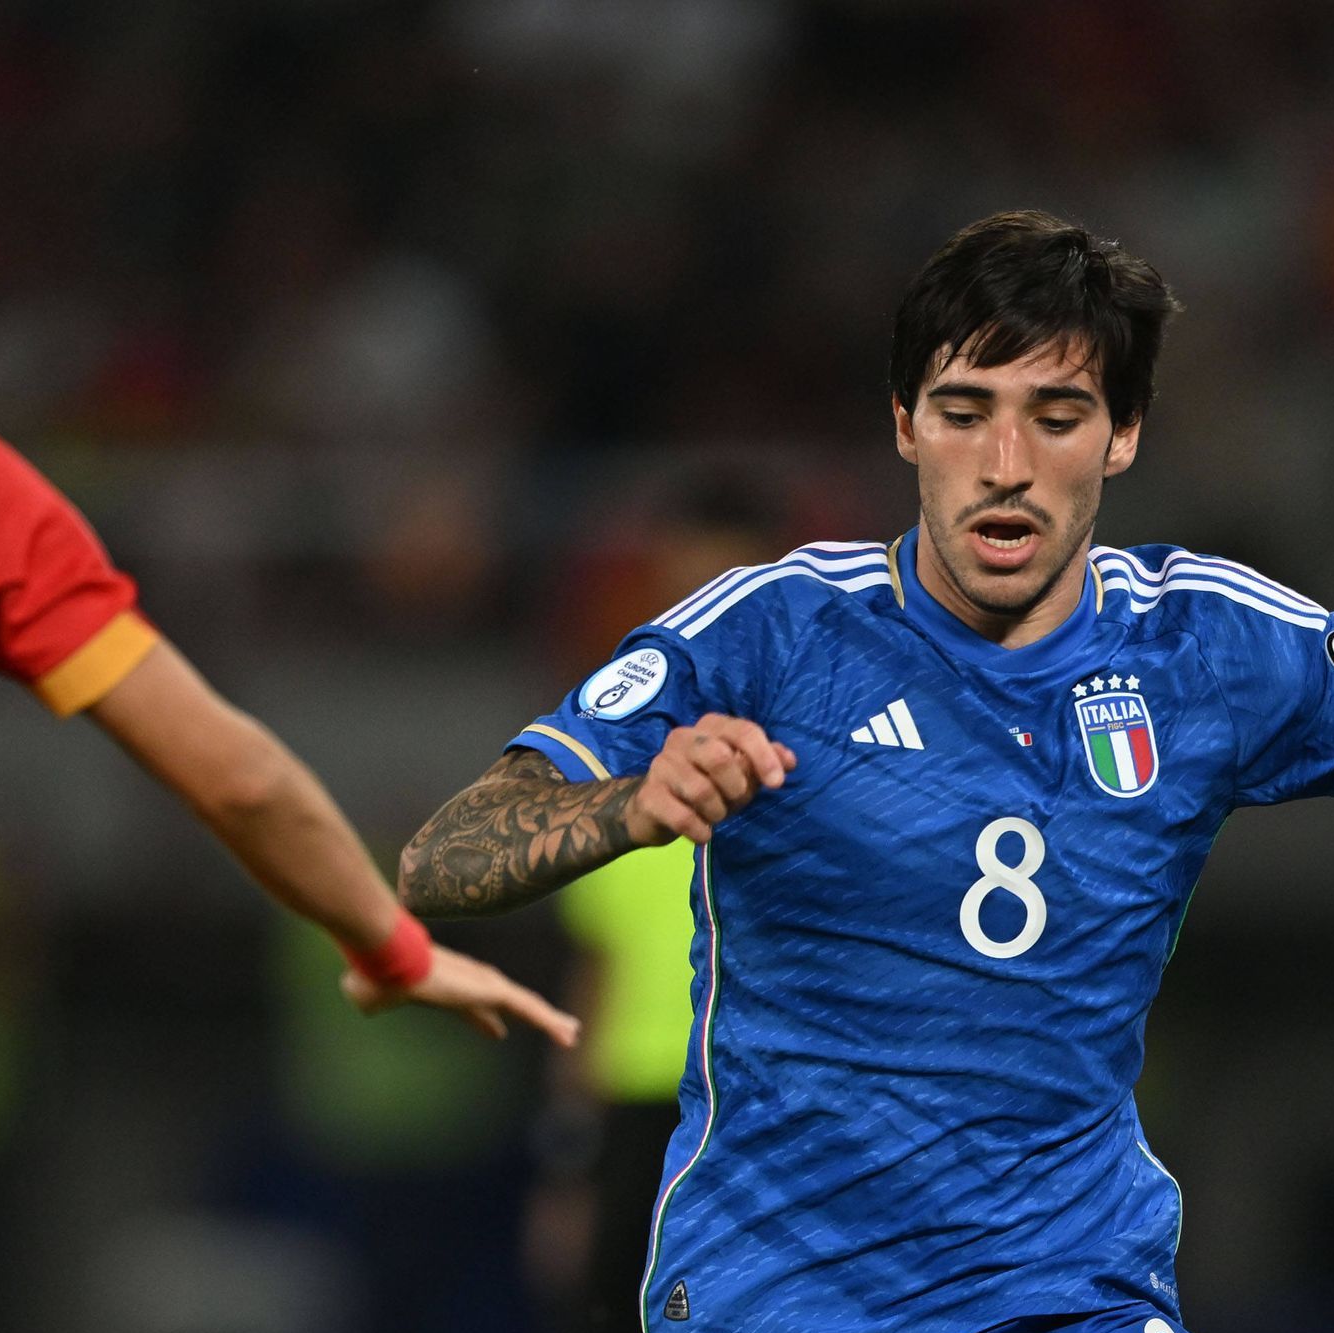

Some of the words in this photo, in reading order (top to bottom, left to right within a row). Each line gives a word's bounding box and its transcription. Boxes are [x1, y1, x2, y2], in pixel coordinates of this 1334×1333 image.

[617, 669, 650, 686] CHAMPIONS
[624, 661, 657, 679] EUROPEAN
[1082, 700, 1143, 725] ITALIA
[1107, 722, 1125, 731] FIGC
[960, 817, 1046, 958] 8
